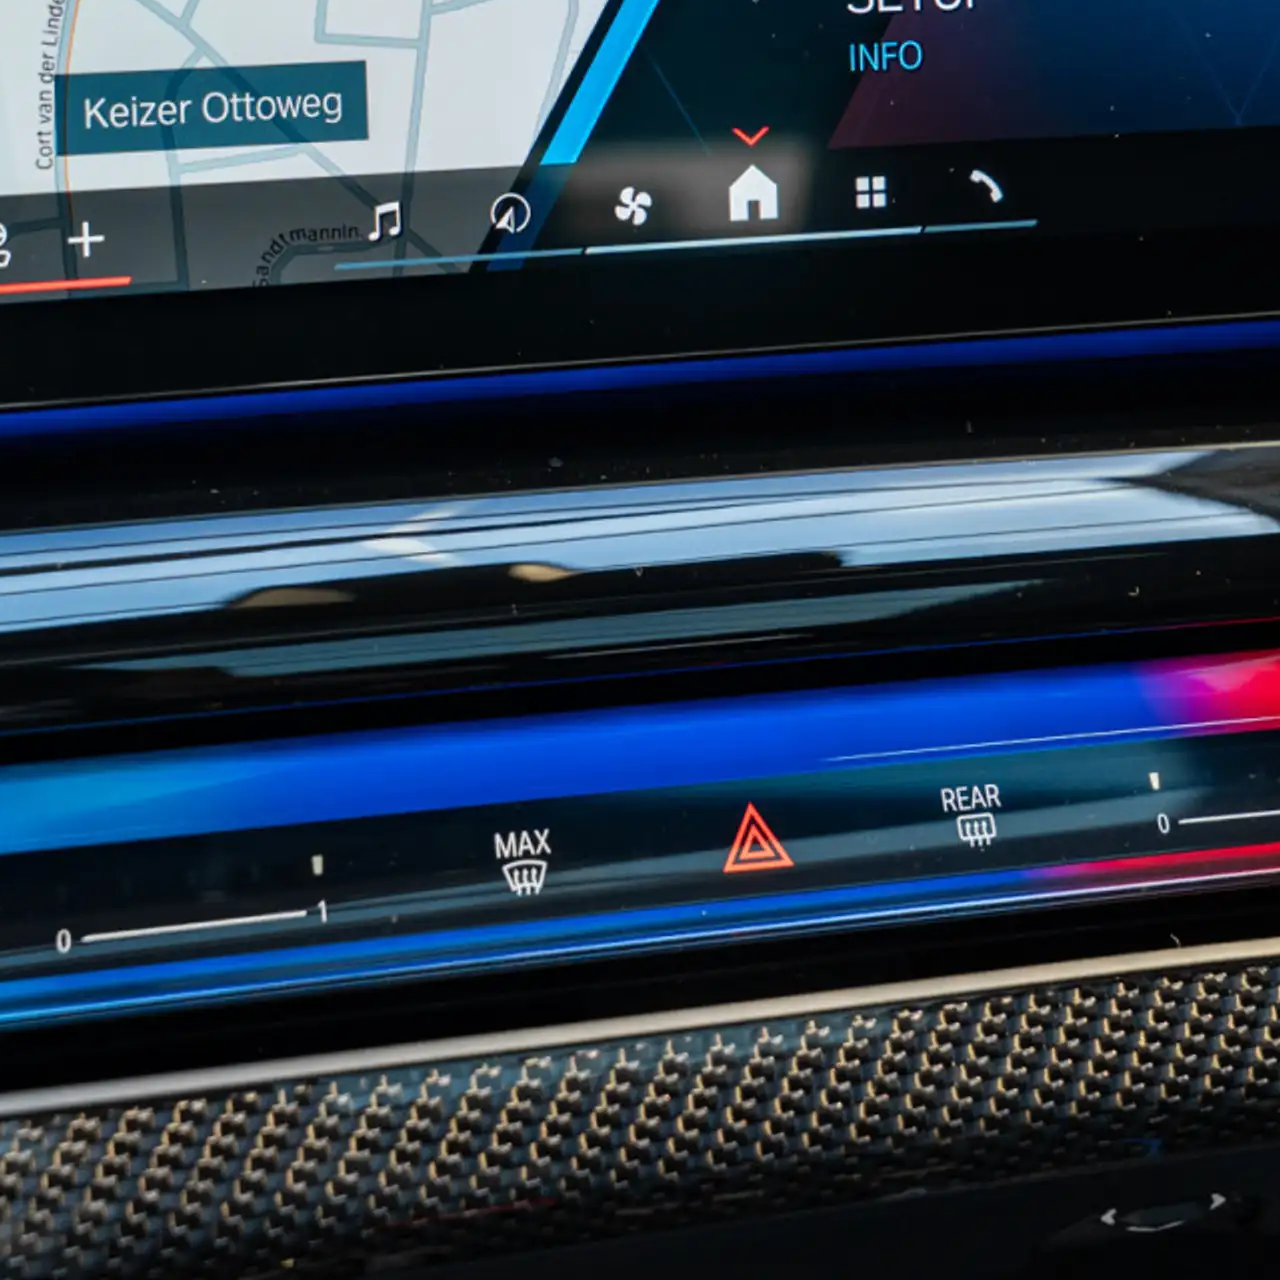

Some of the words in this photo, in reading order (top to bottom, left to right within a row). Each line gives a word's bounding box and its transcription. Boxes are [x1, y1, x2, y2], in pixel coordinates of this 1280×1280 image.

[37, 51, 55, 84] der
[849, 39, 923, 72] INFO
[38, 88, 53, 124] van
[83, 97, 192, 129] Keizer
[201, 91, 342, 123] Ottoweg
[35, 130, 54, 170] Cort
[940, 783, 1002, 814] REAR
[1157, 811, 1171, 835] 0
[494, 828, 552, 860] MAX
[55, 927, 73, 954] 0
[318, 900, 328, 924] 1
